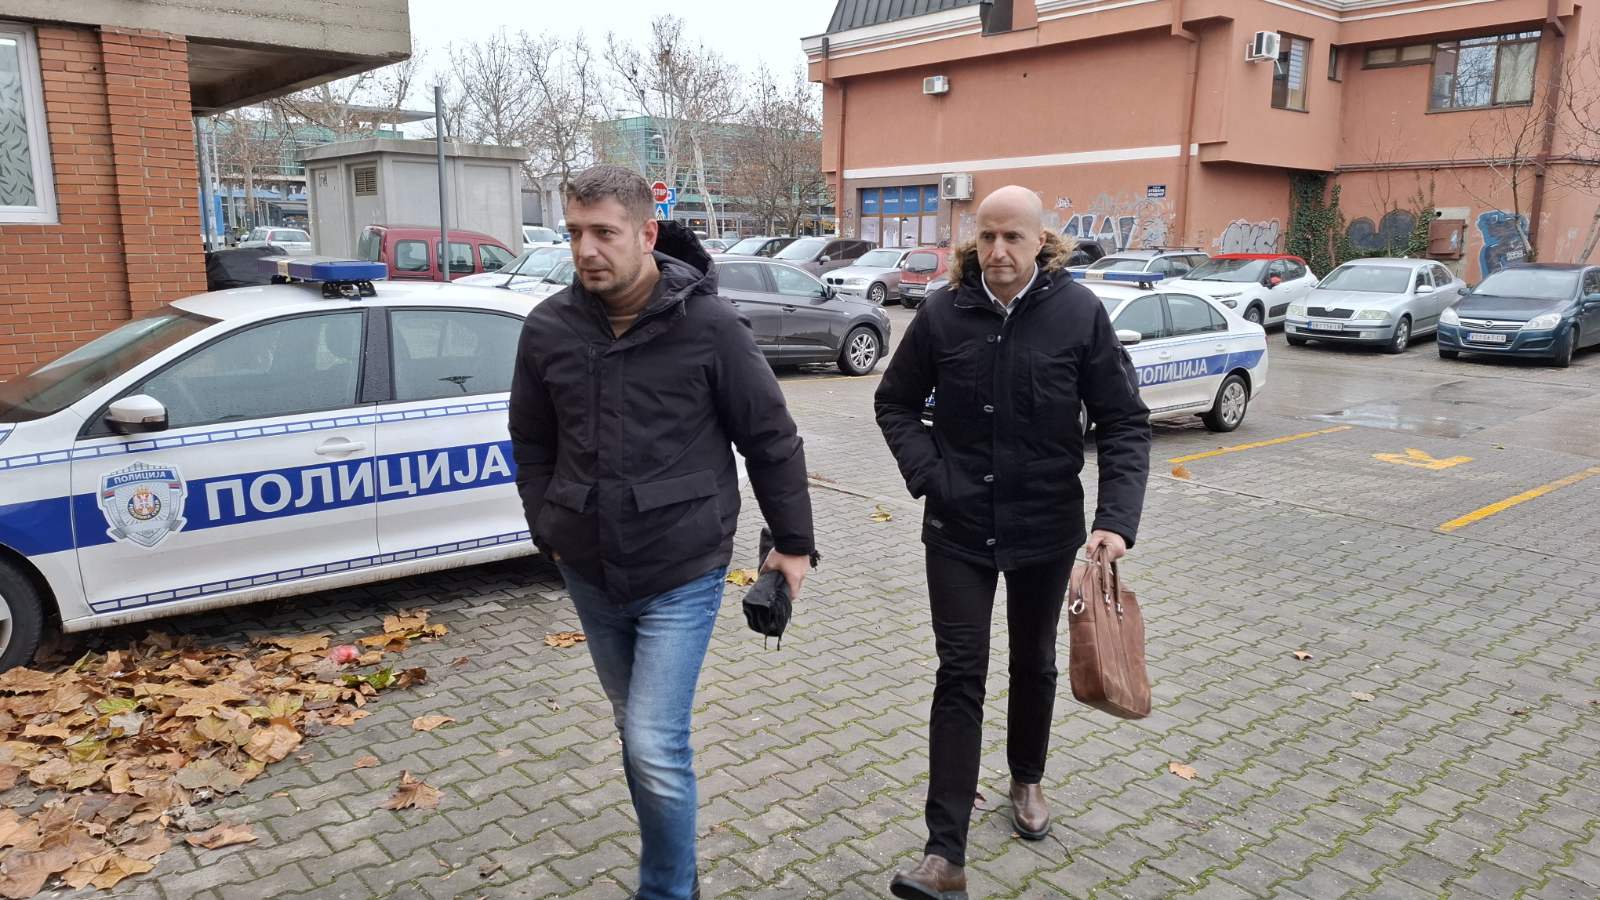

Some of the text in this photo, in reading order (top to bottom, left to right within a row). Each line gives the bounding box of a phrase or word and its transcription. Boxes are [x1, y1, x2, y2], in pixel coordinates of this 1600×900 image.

[652, 188, 667, 196] STOP
[113, 471, 166, 485] ПОЛИЦИЈА
[205, 444, 512, 521] ПОЛИЦИЈА
